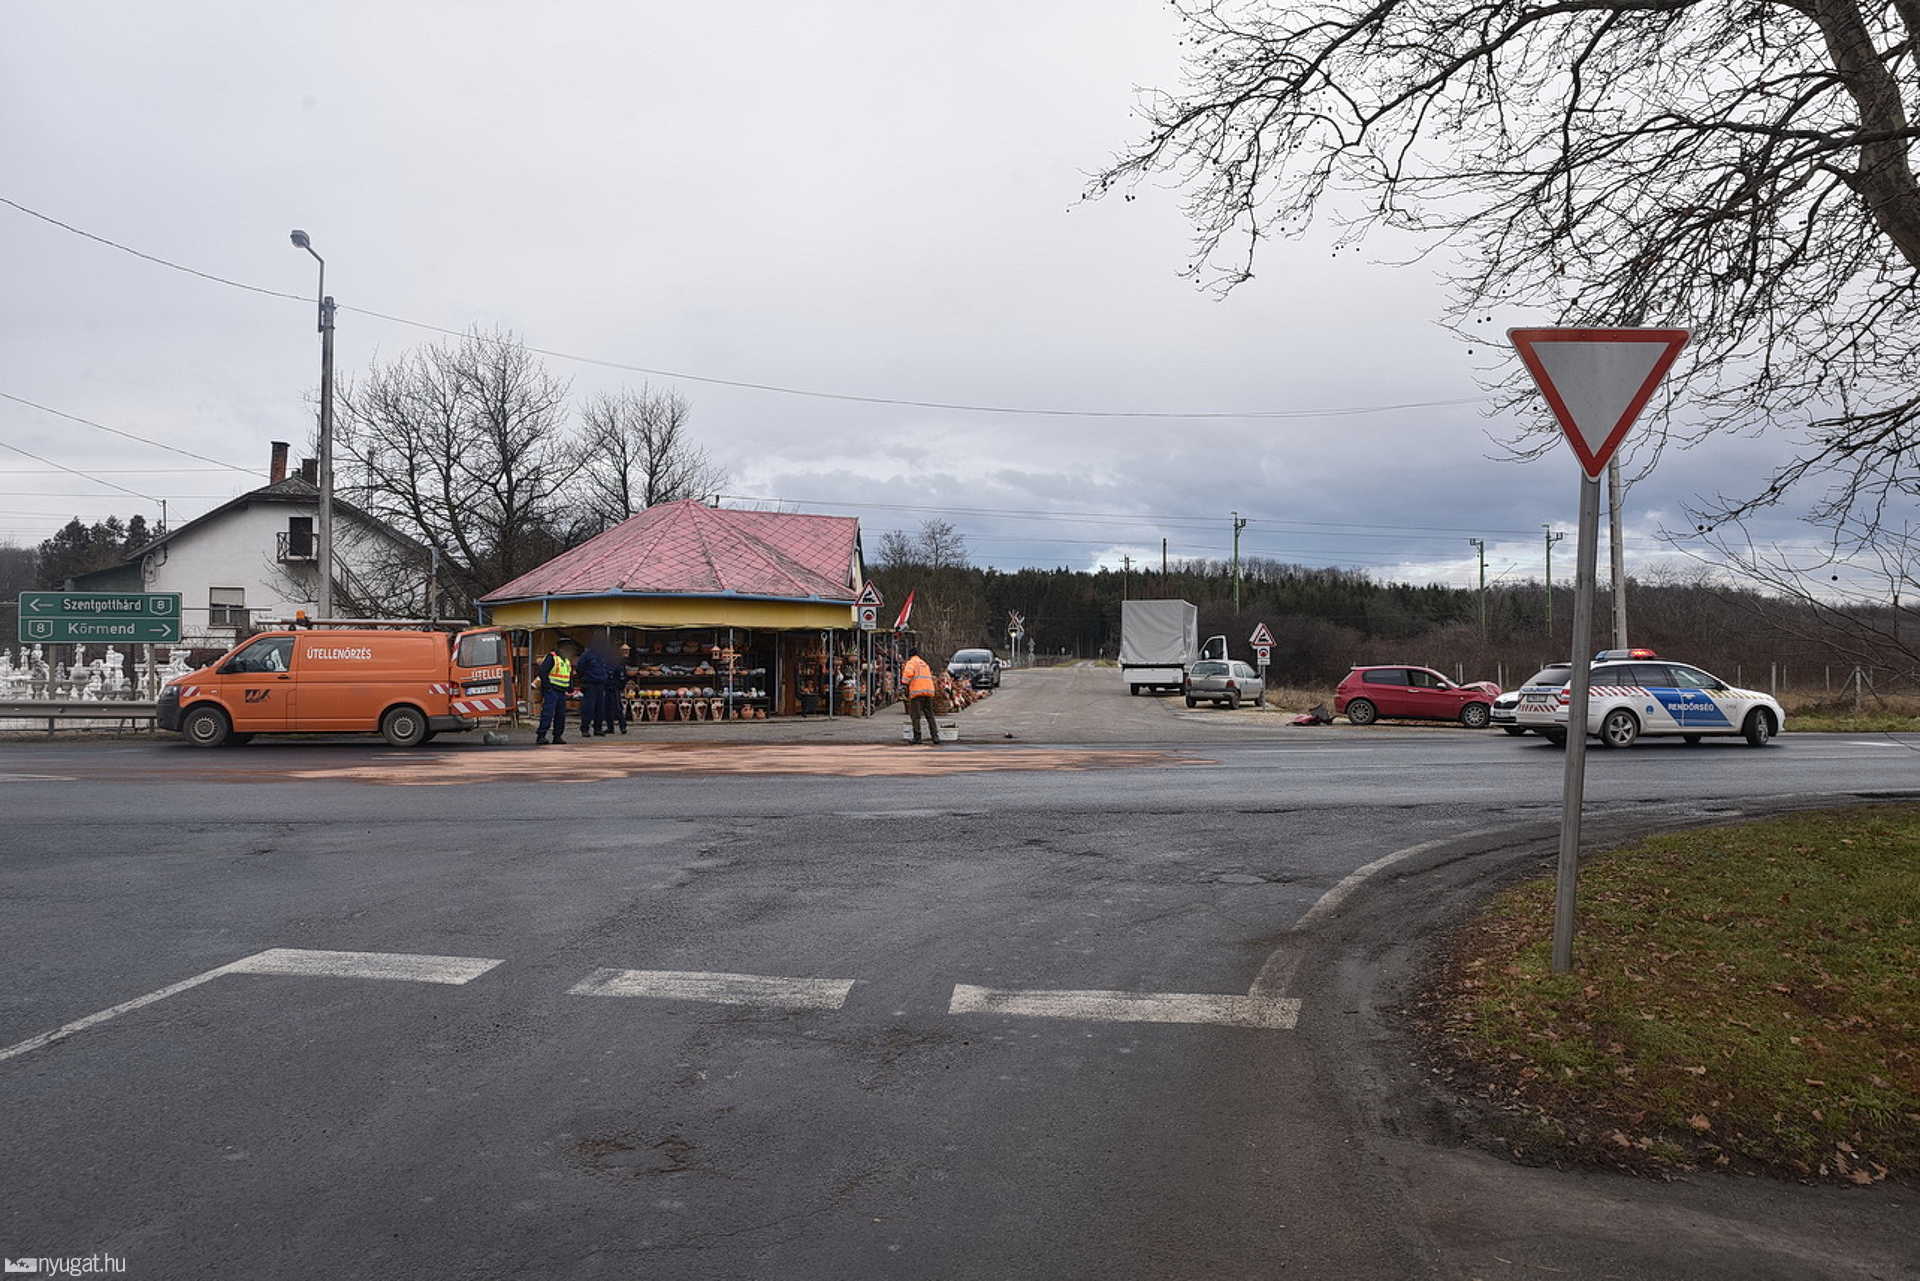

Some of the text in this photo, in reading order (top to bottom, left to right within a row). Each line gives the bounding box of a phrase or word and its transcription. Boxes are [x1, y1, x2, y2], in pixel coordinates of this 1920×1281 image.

[63, 598, 165, 613] Szentgotthárd 8
[36, 622, 136, 635] 8 Körmend
